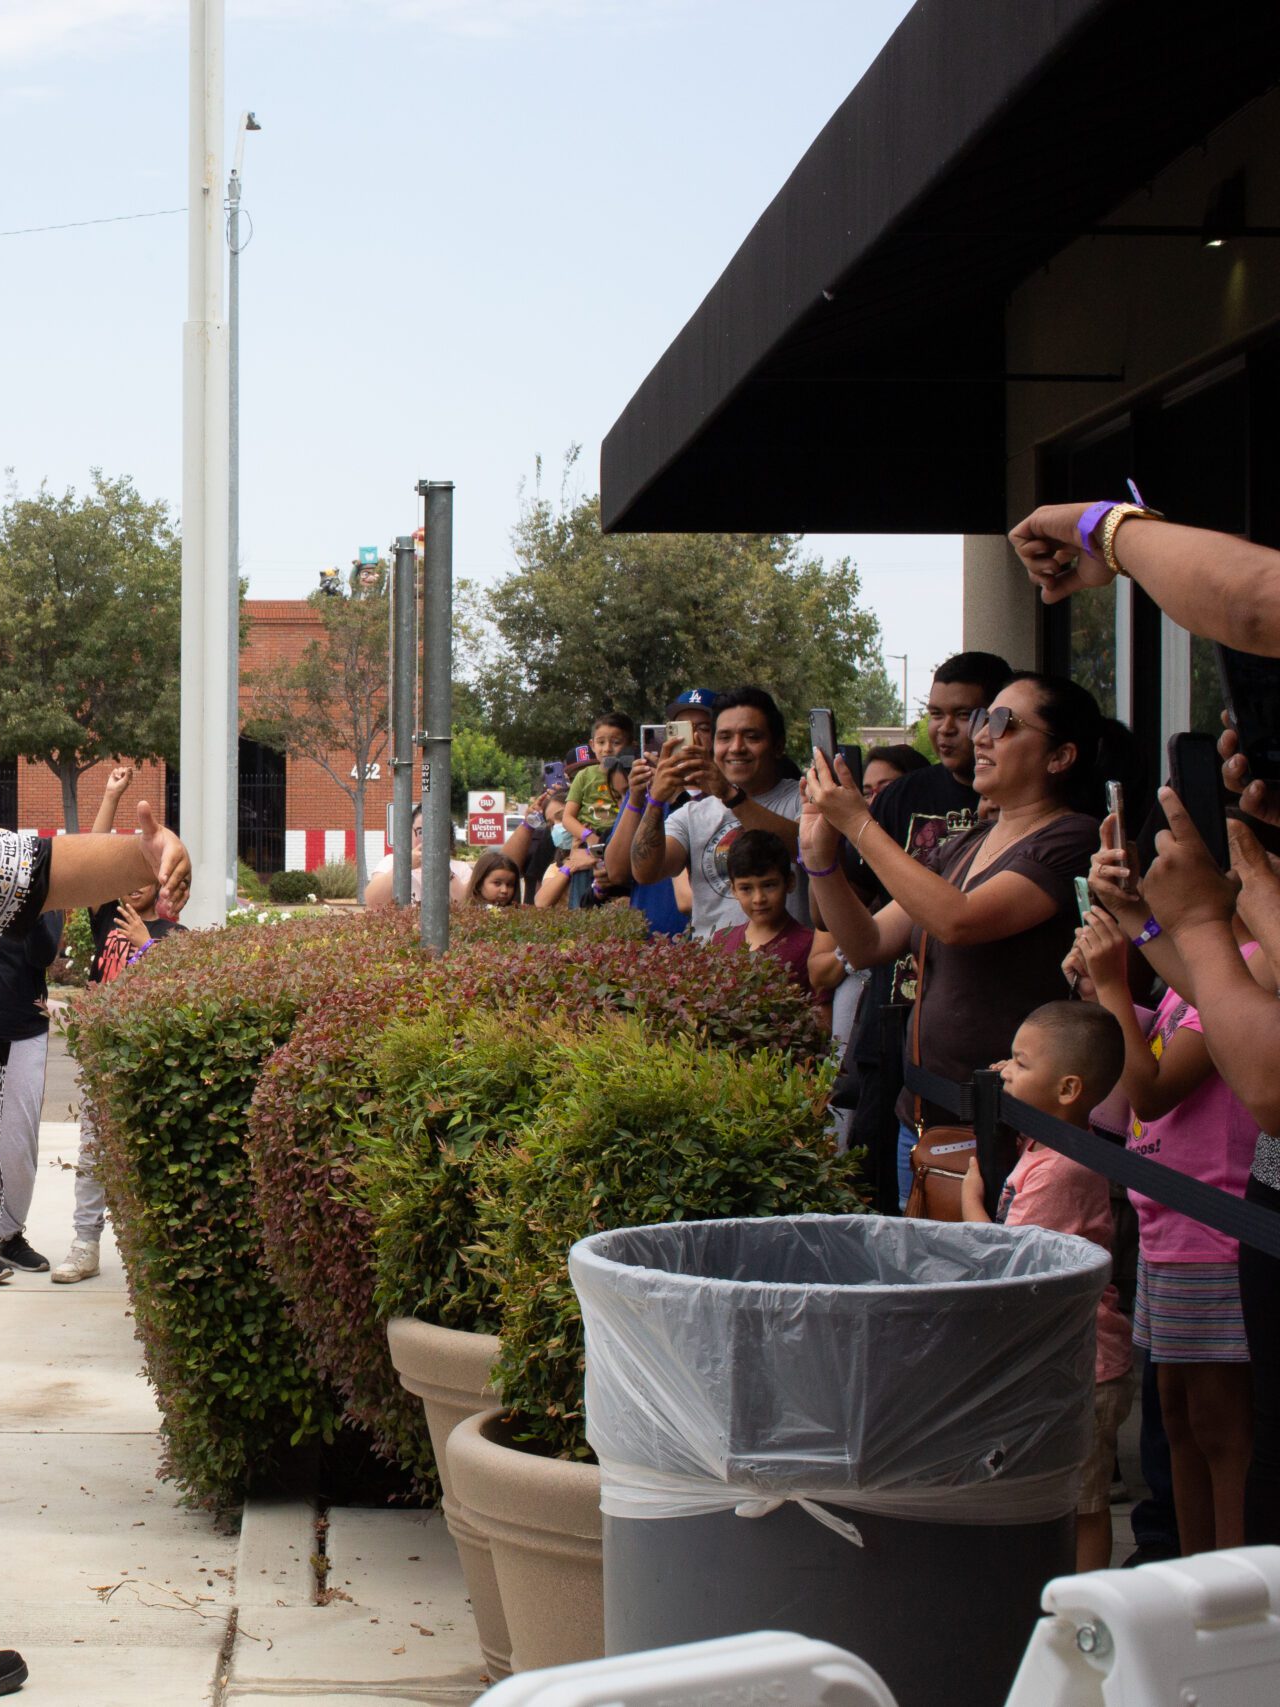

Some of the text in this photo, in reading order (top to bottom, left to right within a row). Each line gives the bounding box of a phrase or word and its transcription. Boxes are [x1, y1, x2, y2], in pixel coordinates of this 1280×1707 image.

[689, 689, 702, 704] LA
[478, 817, 496, 825] Best
[471, 823, 502, 832] Western
[477, 831, 497, 839] PLUS
